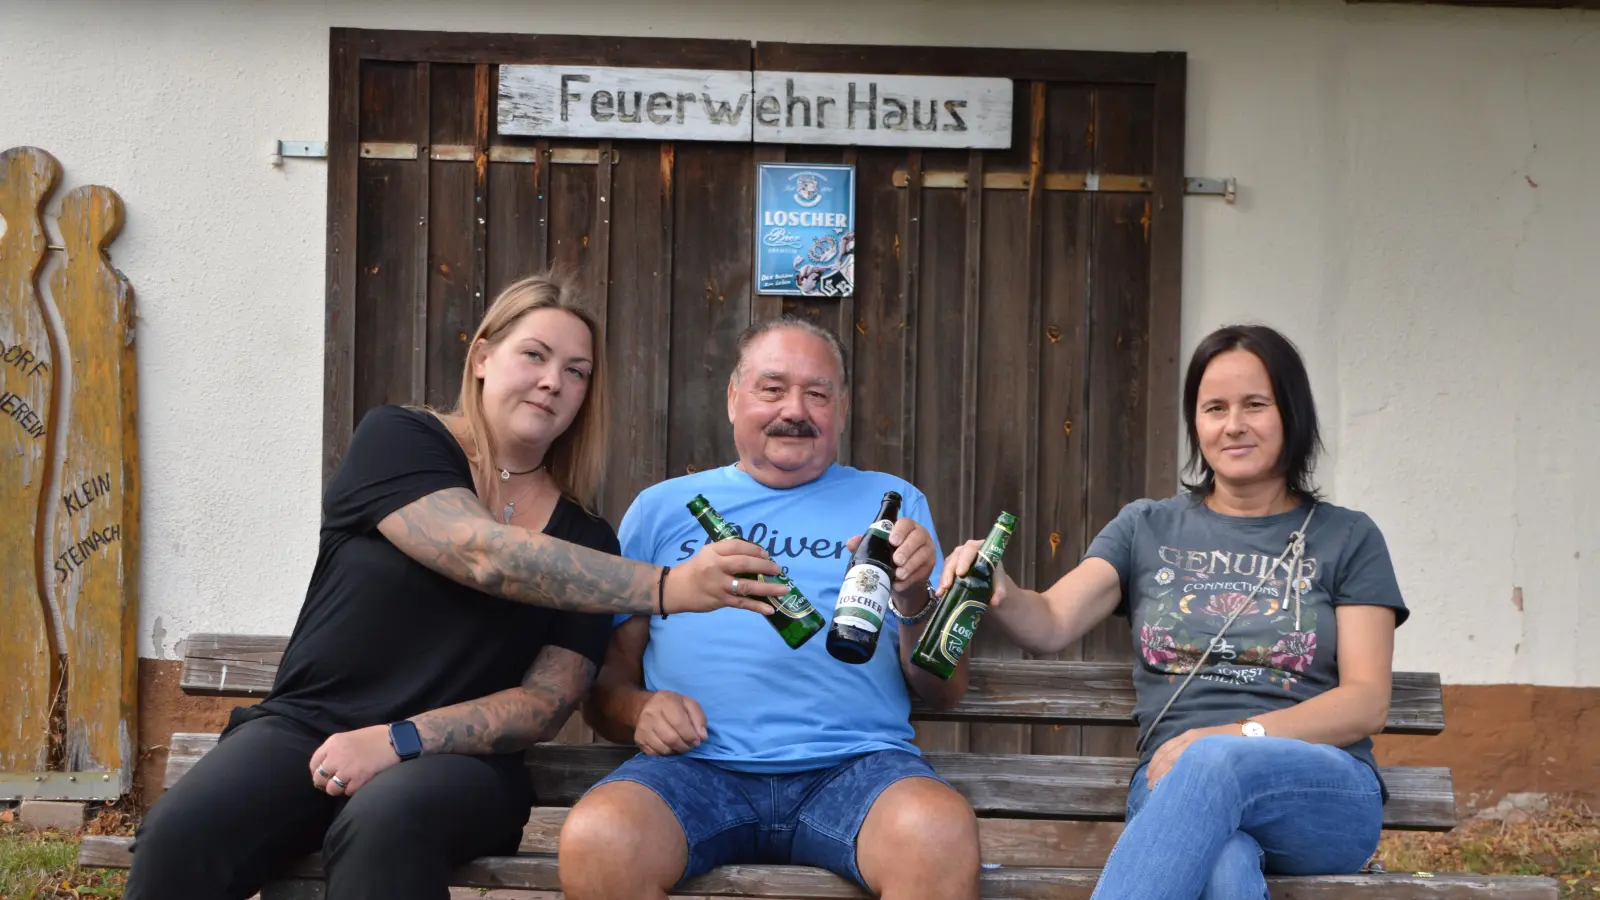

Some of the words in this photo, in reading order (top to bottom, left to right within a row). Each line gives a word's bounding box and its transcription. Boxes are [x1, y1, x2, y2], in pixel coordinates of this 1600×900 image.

[560, 73, 836, 128] Feuerwehr
[847, 81, 968, 132] Haus
[765, 211, 848, 228] LOSCHER
[764, 227, 802, 248] Bier
[63, 472, 110, 517] KLEIN
[54, 524, 120, 583] STEINACH
[1183, 581, 1279, 597] CONNECTIONS
[839, 595, 884, 614] LOSCHER
